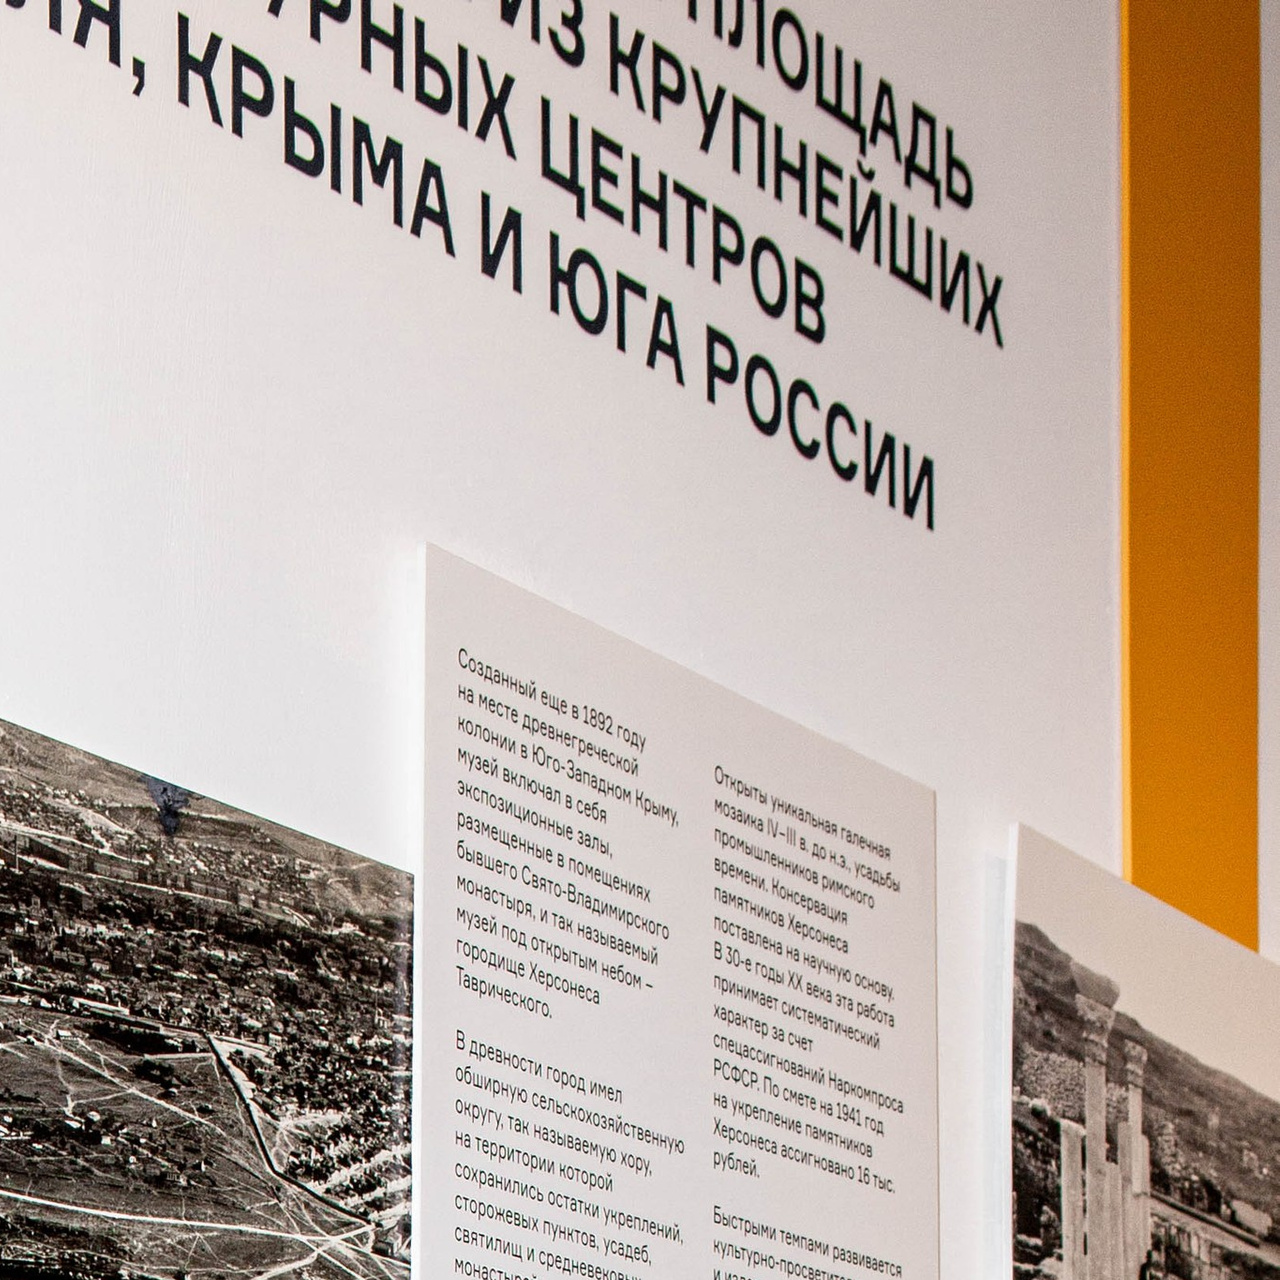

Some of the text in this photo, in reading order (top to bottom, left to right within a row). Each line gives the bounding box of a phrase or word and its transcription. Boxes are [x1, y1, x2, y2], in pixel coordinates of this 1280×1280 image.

[540, 95, 826, 345] ЦЕНТРОВ
[609, 11, 1004, 349] КРУПНЕЙШИХ
[177, 11, 456, 258] КРЫМА
[480, 190, 522, 295] И
[549, 230, 685, 386] ЮГА
[705, 324, 936, 531] РОССИИ
[457, 683, 639, 778] на месте древнегреческой
[458, 647, 647, 755] Созданный еще в 1892 году
[457, 715, 679, 828] колонии в Юго-Западном Крыму,
[457, 779, 613, 860] экспозиционные залы,
[714, 764, 891, 861] Открыты уникальная галечная
[456, 839, 670, 941] бывшего Свято-Владимирского
[457, 811, 651, 904] размещенные в помещениях
[713, 857, 848, 926] времени. Консервация
[714, 827, 875, 910] промышленников римского
[713, 886, 849, 955] памятников Херсонеса
[455, 964, 553, 1020] Таврического.
[456, 938, 600, 1006] городище Херсонеса
[713, 974, 881, 1050] принимает систематический
[455, 1065, 685, 1155] обширную сельскохозяйственную
[713, 1033, 904, 1114] спецассигнований Наркомпроса
[713, 1057, 885, 1138] РСФСР. По смете на 1941 год
[455, 1130, 614, 1193] на территории которой
[713, 1091, 873, 1159] на укрепление памятников
[713, 1150, 760, 1179] рублей.
[454, 1162, 684, 1246] сохранились остатки укреплений,
[454, 1194, 652, 1267] сторожевых пунктов, усадеб,
[454, 1226, 524, 1263] святилищ
[526, 1246, 535, 1263] и
[713, 1204, 903, 1279] Быстрыми темпами развивается
